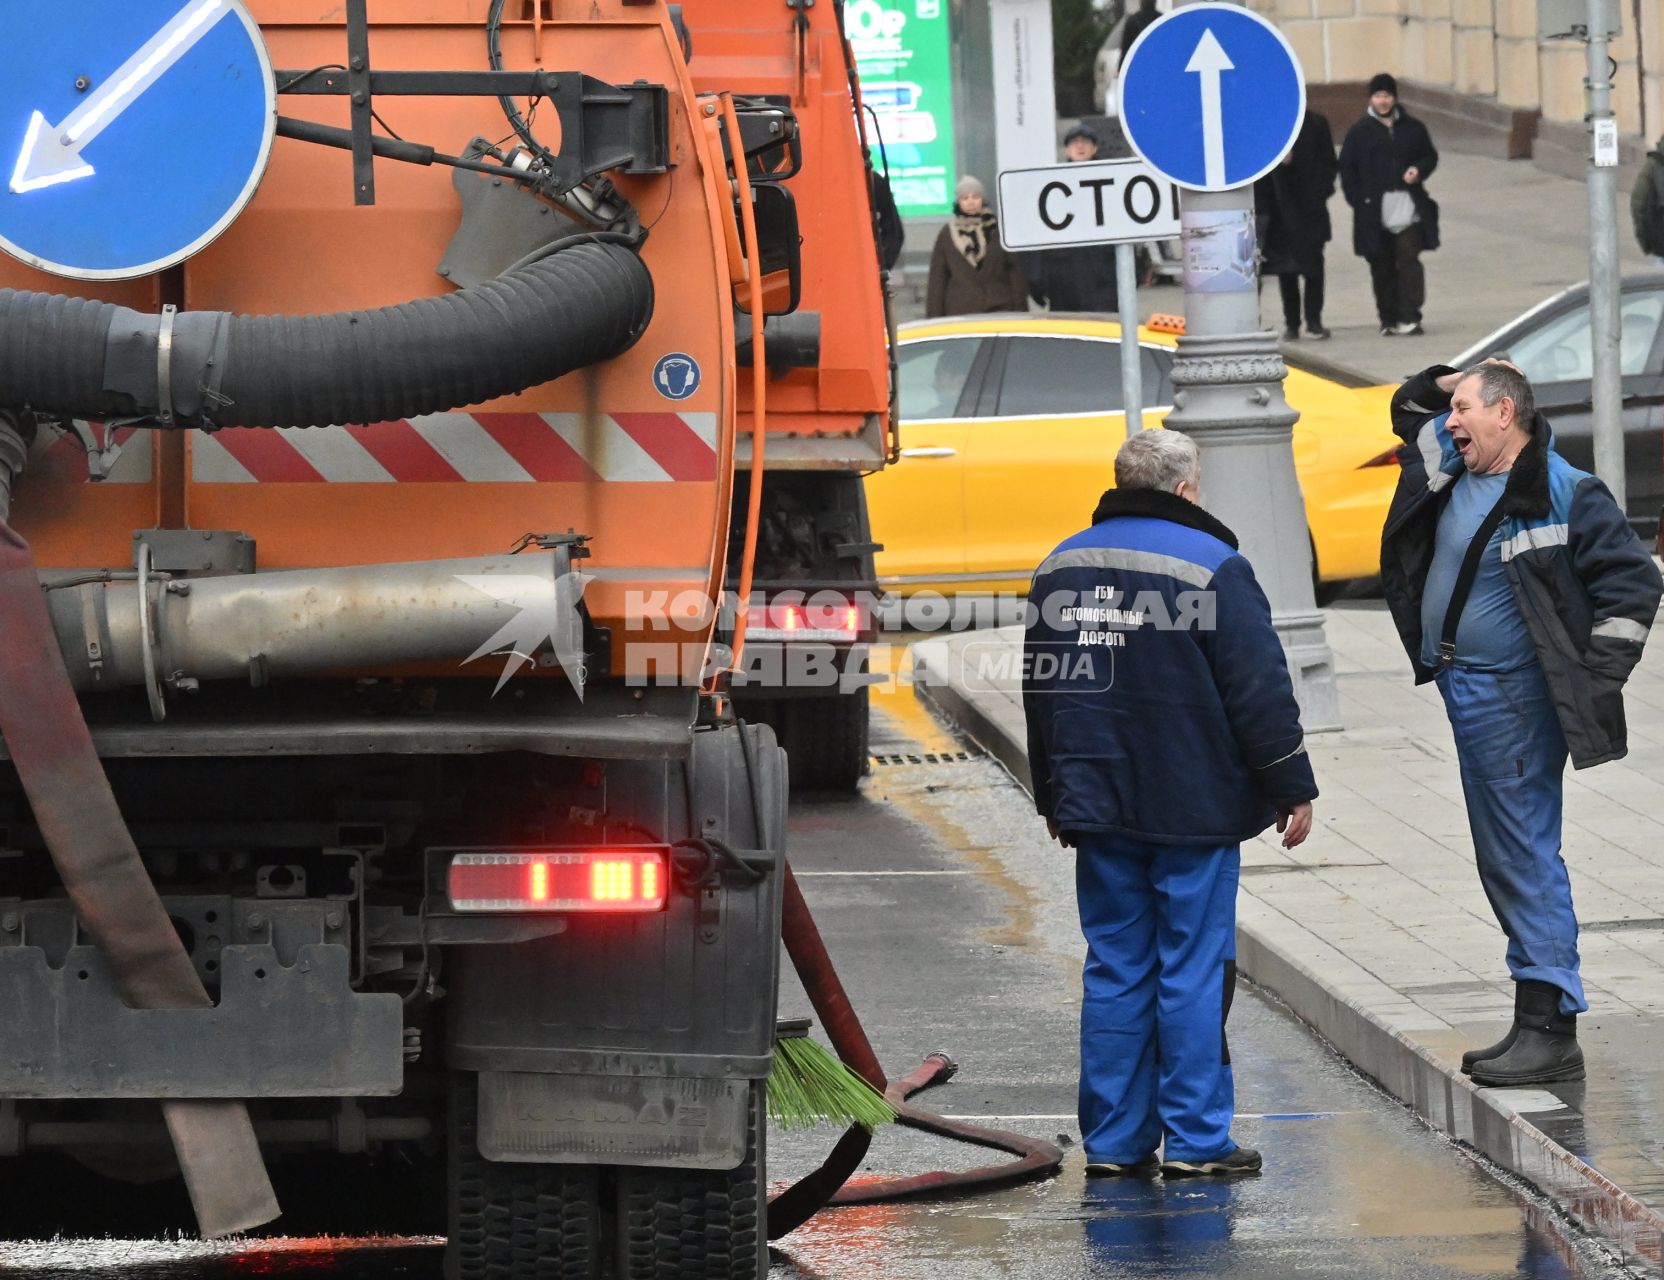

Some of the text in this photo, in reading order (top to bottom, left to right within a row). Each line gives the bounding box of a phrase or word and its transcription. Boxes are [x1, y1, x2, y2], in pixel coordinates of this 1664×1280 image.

[1094, 585, 1115, 600] ГБУ
[1061, 606, 1144, 626] АВТОМОБИЛЬНЫЕ
[1077, 630, 1126, 647] ДОРОГИ
